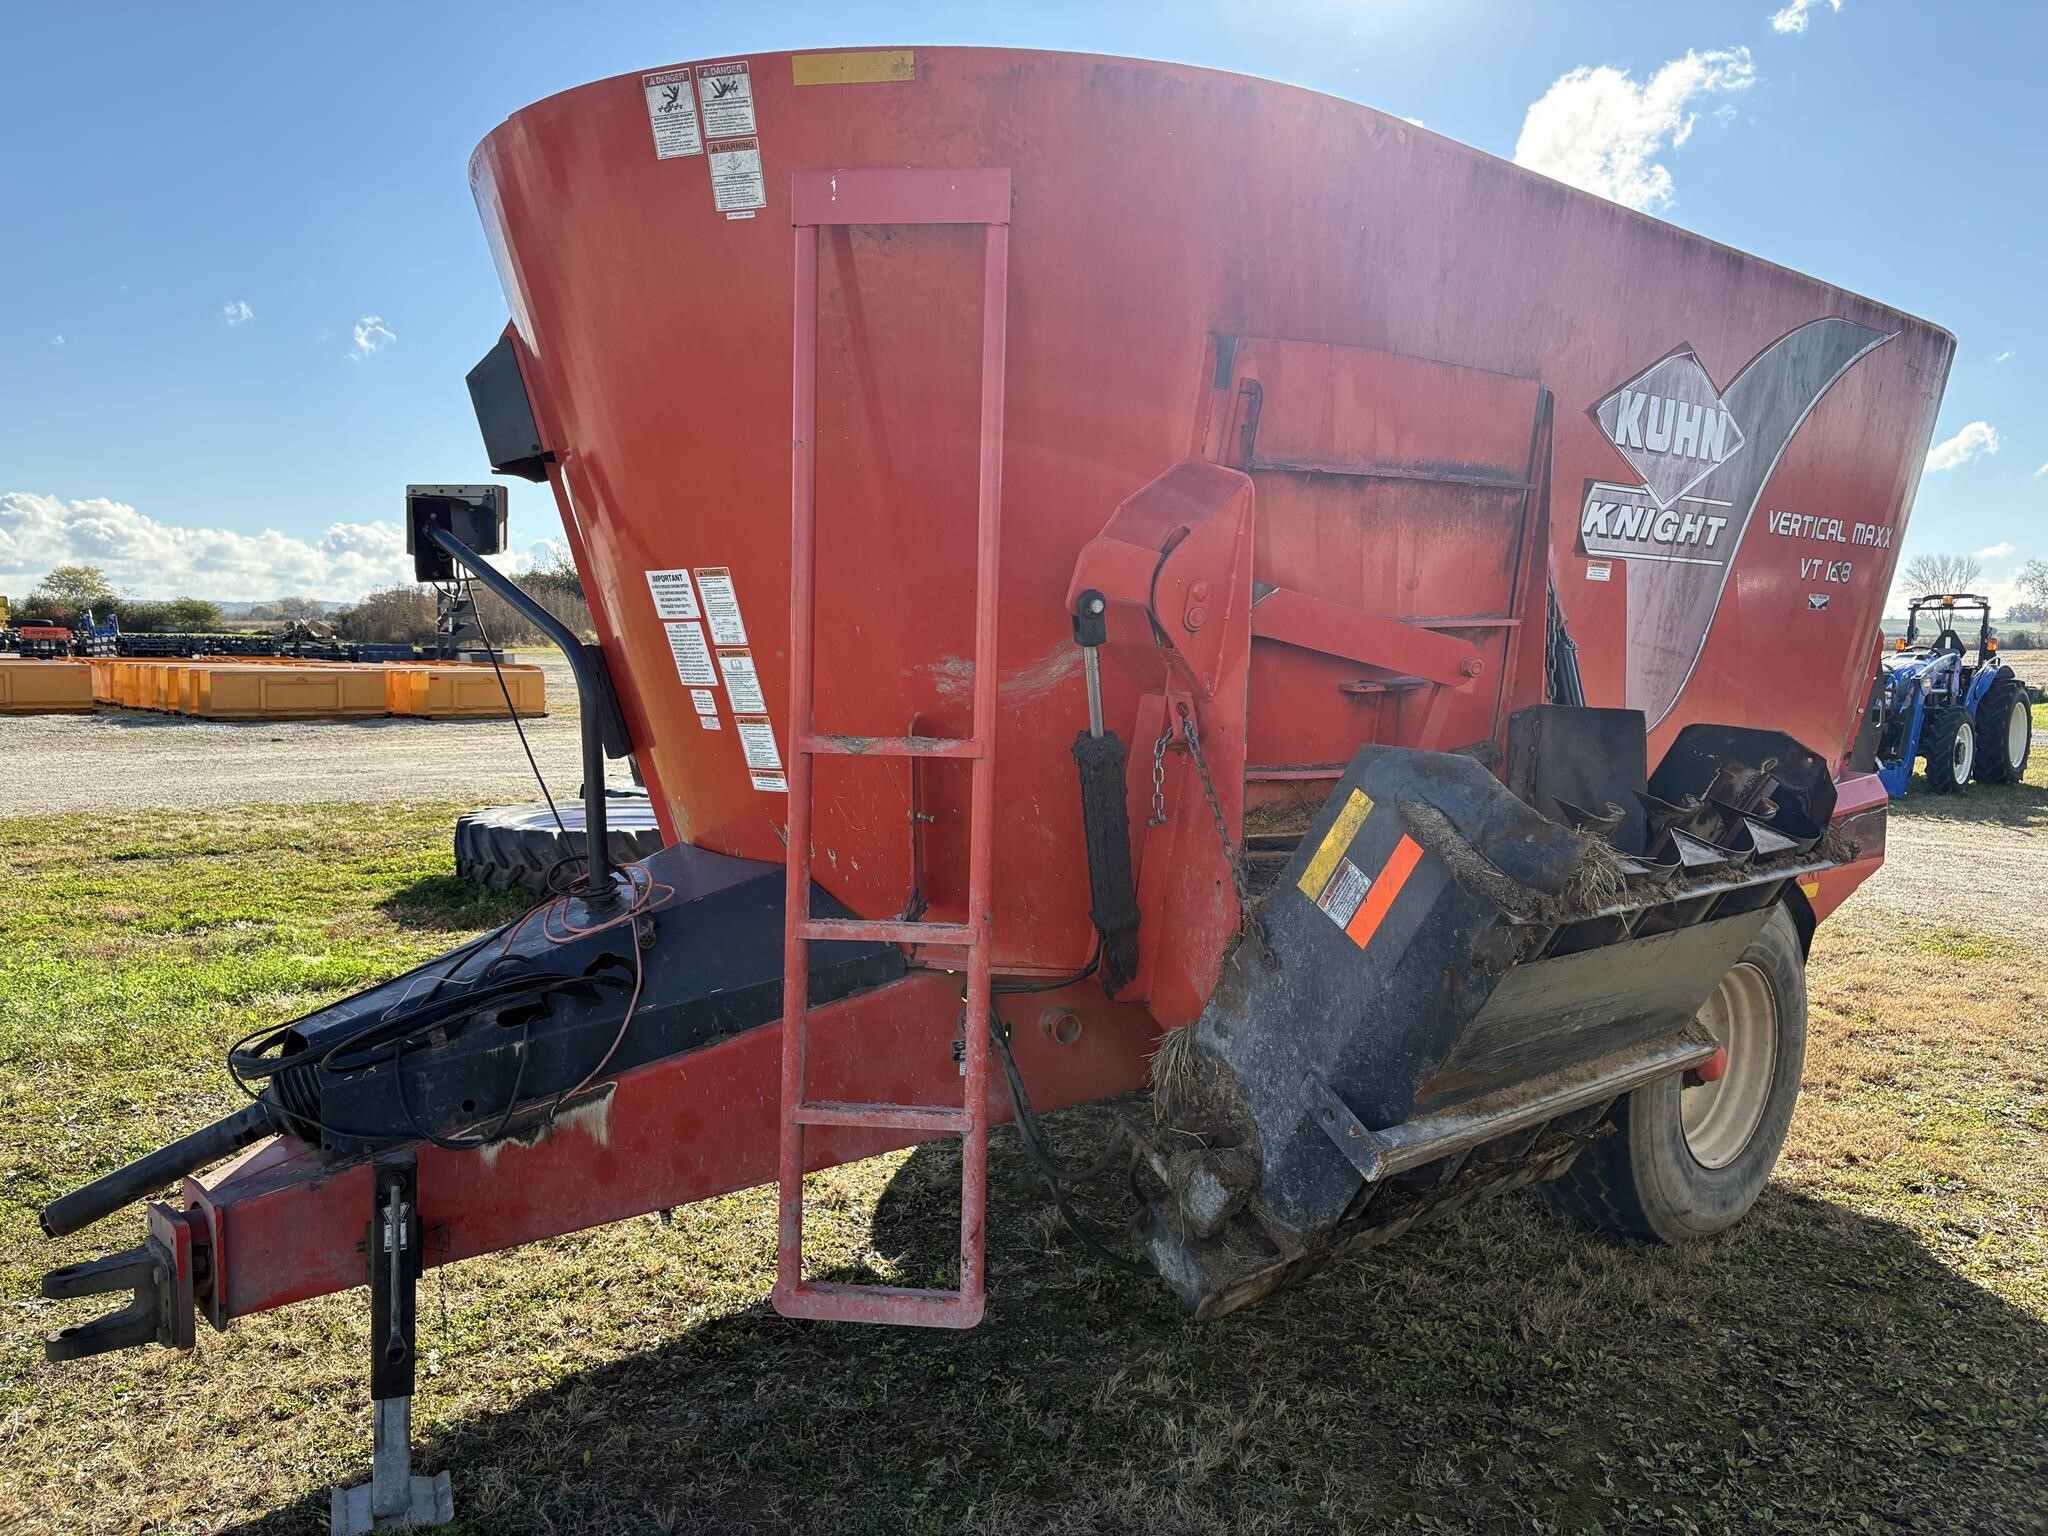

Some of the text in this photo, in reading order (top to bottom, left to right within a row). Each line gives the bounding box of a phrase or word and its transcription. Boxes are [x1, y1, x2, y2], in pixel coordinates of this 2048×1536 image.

[655, 73, 685, 83] DANGER
[709, 65, 742, 76] DANGER
[719, 140, 754, 152] WARNING
[1614, 389, 1729, 464] KUHN
[1582, 500, 1728, 548] KNIGHT
[1768, 510, 1894, 549] VERTICAL MAXX
[652, 574, 683, 582] IMPORTANT
[1800, 558, 1823, 581] VT
